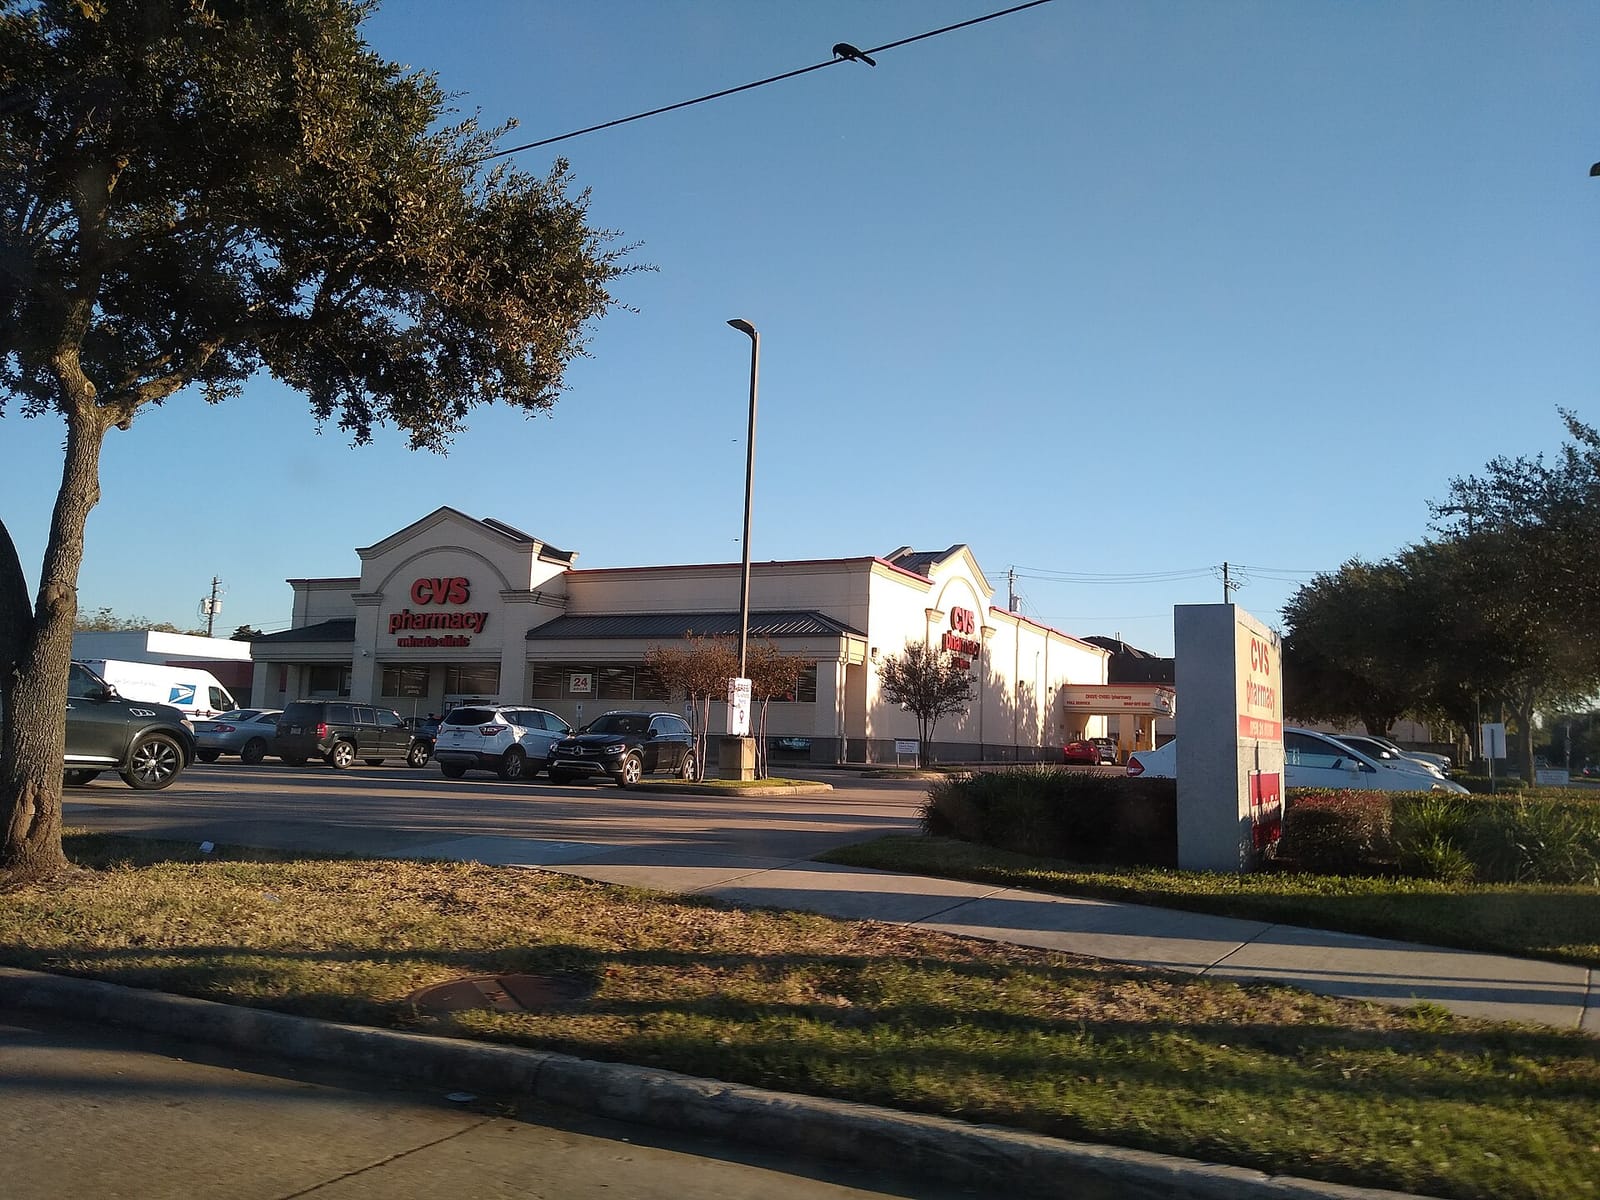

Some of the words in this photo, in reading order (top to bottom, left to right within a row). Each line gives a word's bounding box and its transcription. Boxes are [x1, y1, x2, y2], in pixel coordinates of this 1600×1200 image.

[411, 577, 470, 605] CVS
[388, 609, 488, 634] pharmacy
[951, 606, 975, 635] CVS
[1251, 638, 1269, 676] CVS
[574, 677, 588, 687] 24
[1246, 674, 1275, 718] pharmacy
